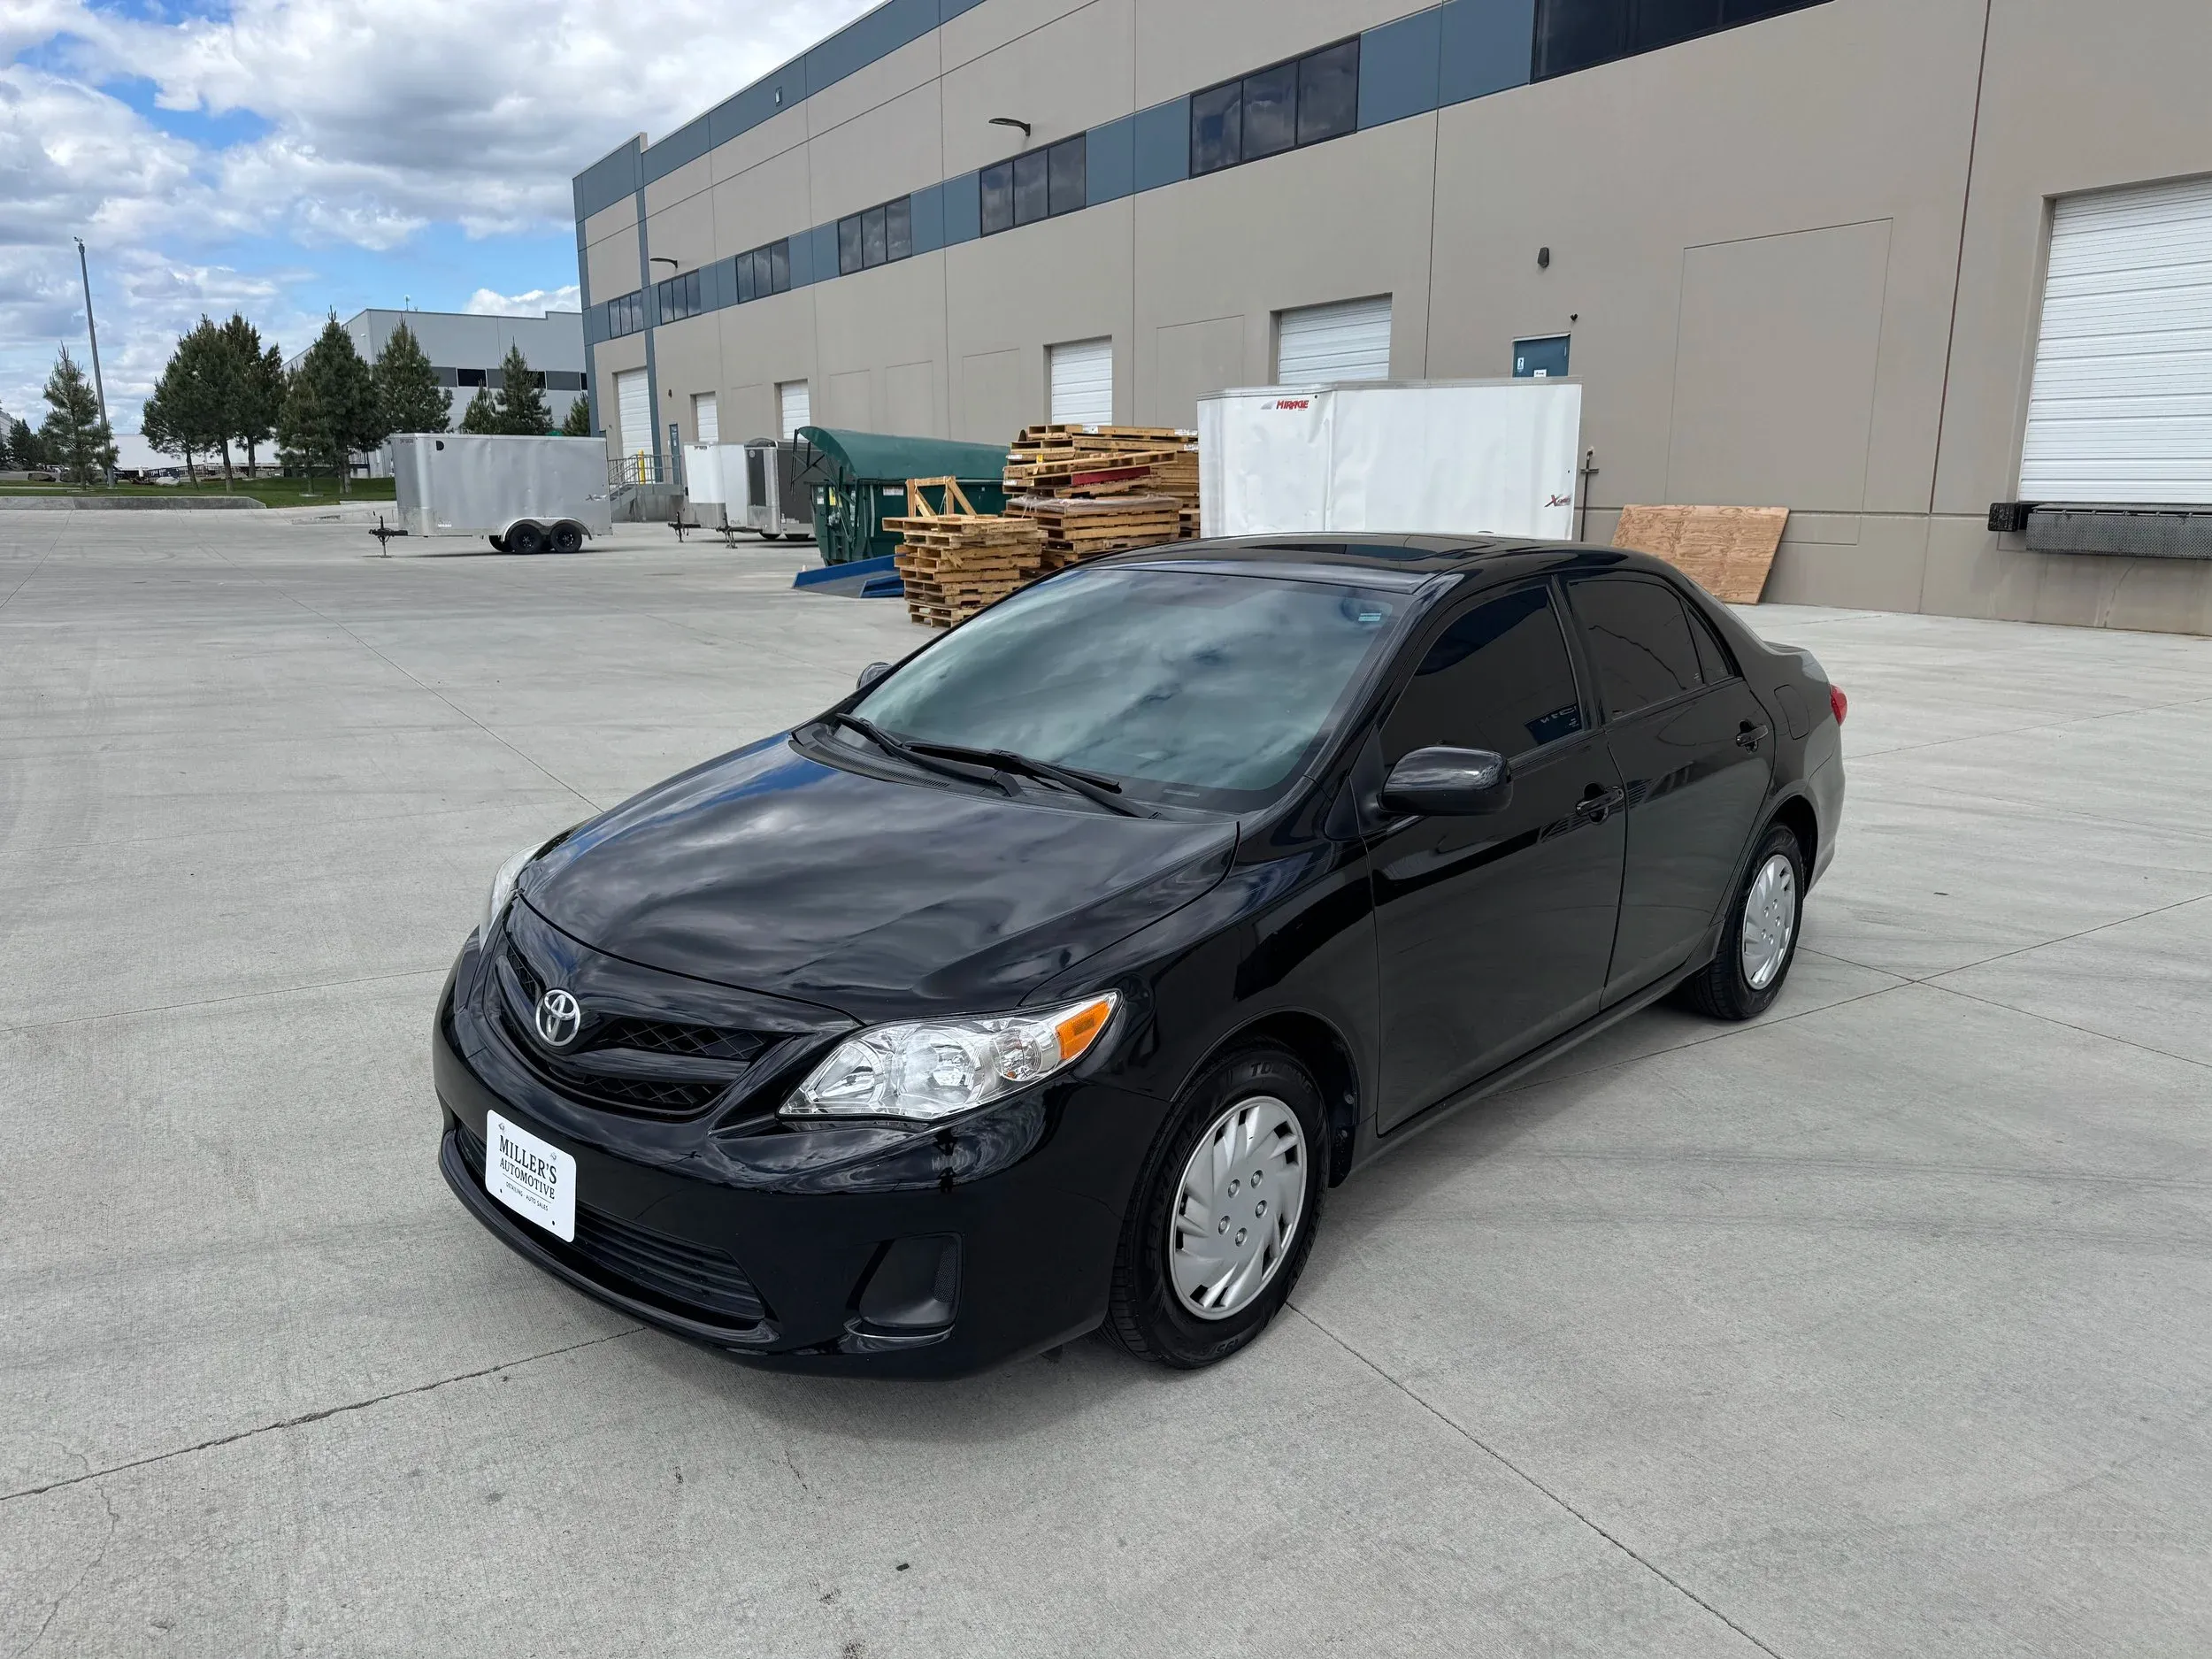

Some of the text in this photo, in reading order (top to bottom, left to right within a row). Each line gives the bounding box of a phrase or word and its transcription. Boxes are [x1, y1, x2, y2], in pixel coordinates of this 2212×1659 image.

[1276, 399, 1310, 410] MIRAGE
[499, 1134, 557, 1185] MILLER'S
[499, 1157, 556, 1200] AUTOMOTIVE
[505, 1181, 549, 1211] DETAILING AUTO SALES
